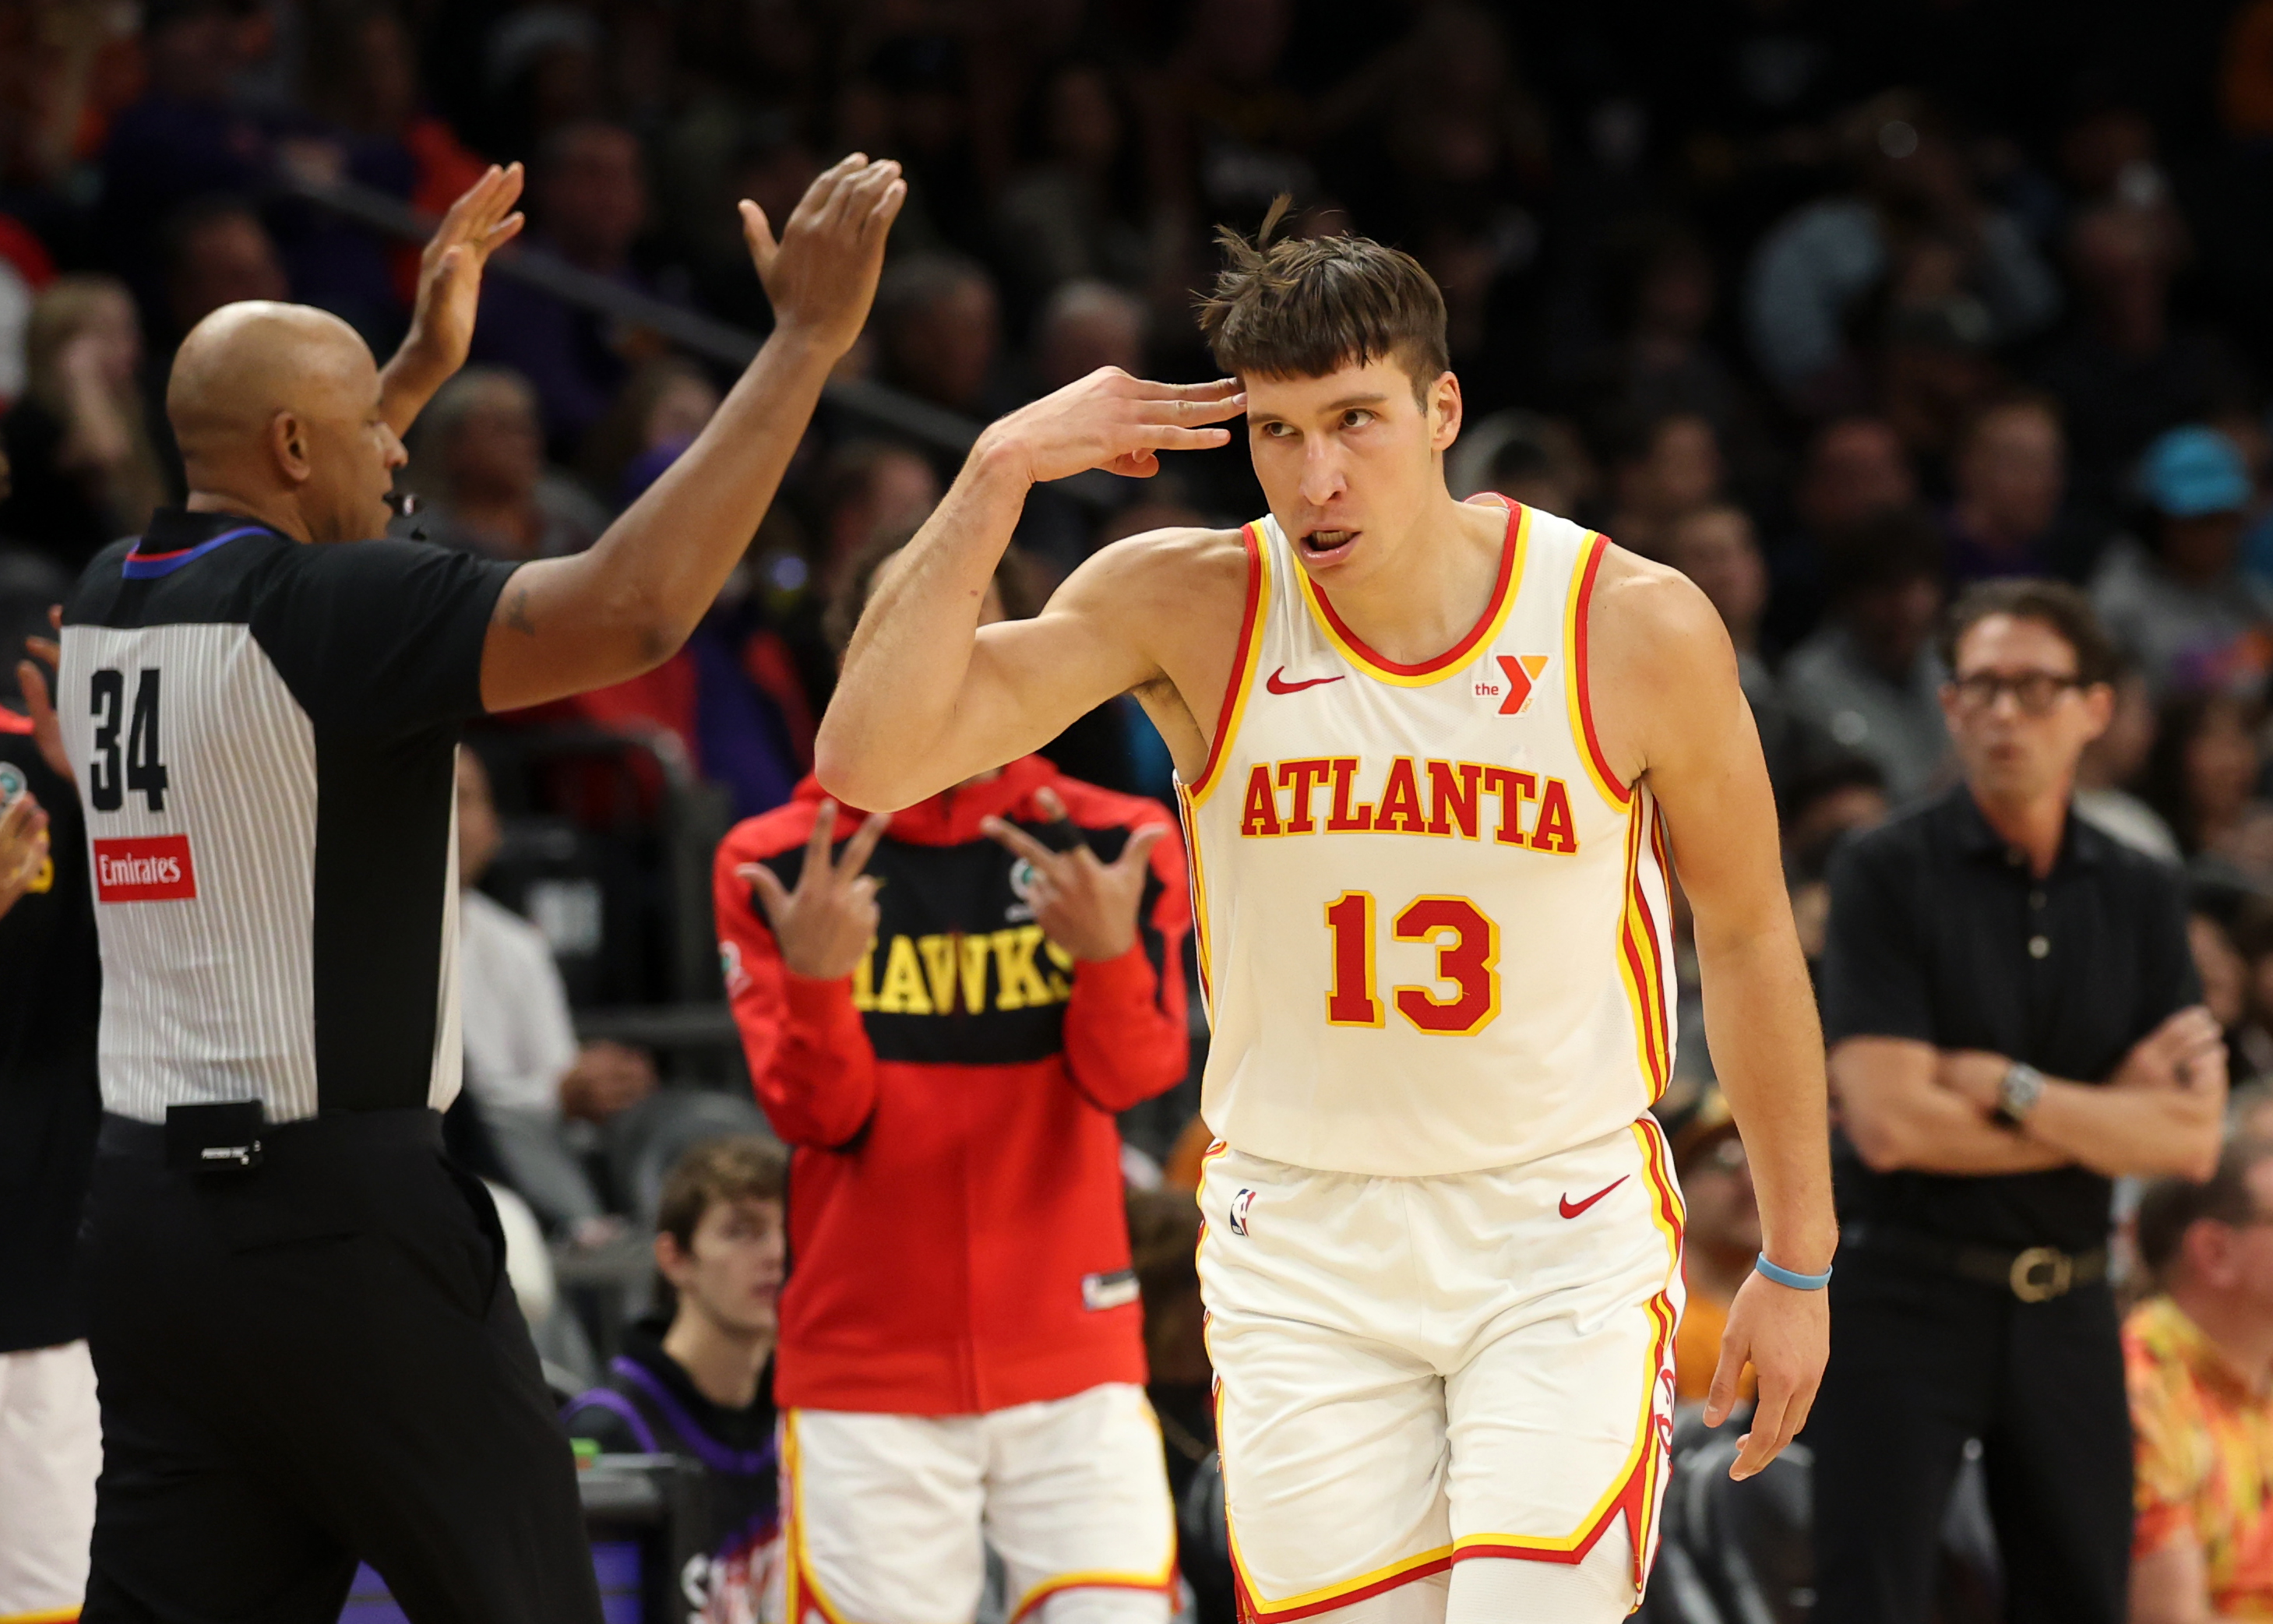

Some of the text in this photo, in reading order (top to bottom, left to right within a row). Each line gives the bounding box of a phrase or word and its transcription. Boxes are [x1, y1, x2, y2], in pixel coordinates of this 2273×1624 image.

[1475, 682, 1499, 696] the
[90, 668, 167, 812] 34
[1240, 755, 1580, 856] ATLANTA
[99, 852, 181, 886] Emirates
[1324, 890, 1501, 1037] 13
